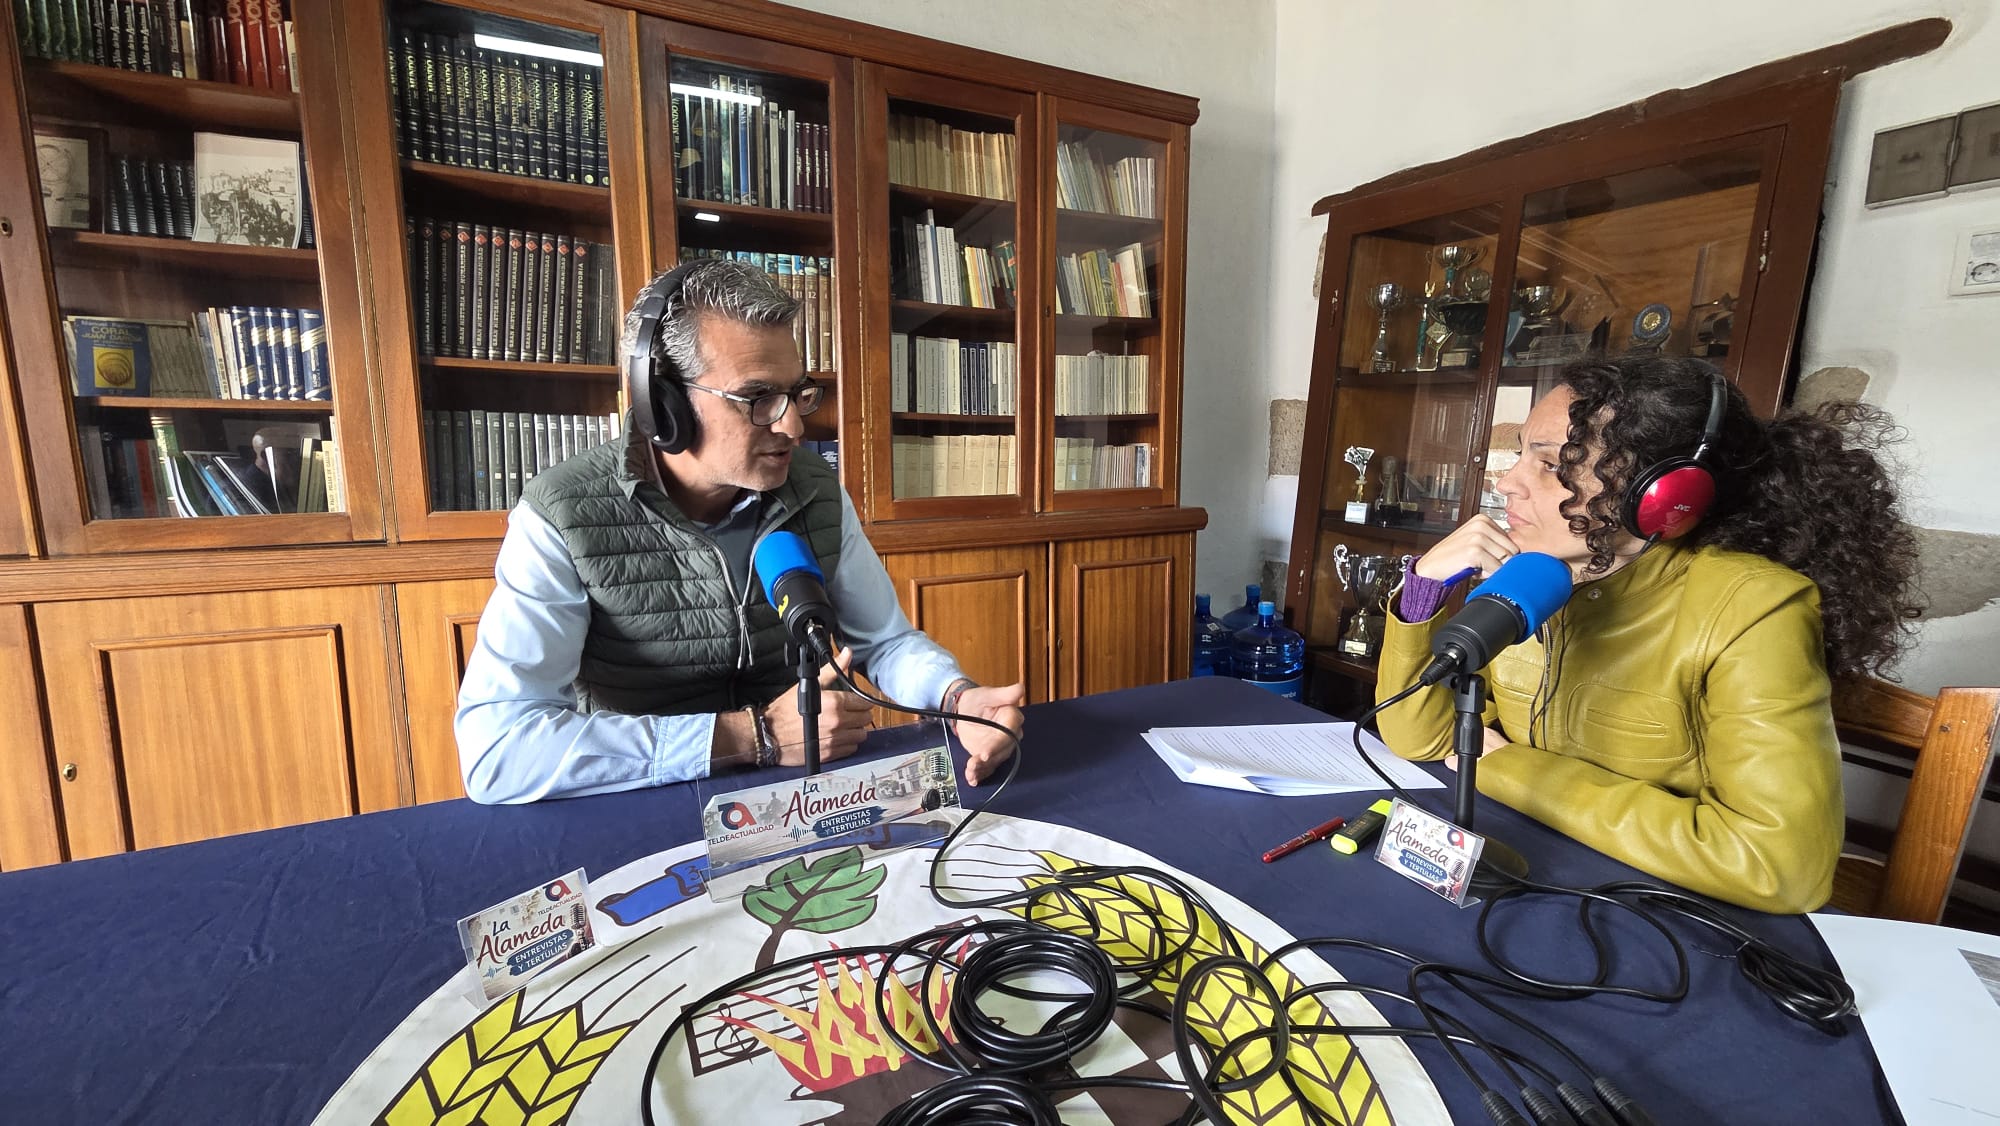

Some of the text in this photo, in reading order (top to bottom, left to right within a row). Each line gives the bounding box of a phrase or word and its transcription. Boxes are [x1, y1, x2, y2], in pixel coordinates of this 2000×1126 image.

[808, 291, 816, 299] 12
[577, 299, 582, 309] DE
[1673, 504, 1691, 512] JVC
[802, 780, 820, 796] La
[781, 781, 878, 828] Alameda
[821, 809, 871, 828] ENTREVISTAS
[831, 817, 871, 834] TERTULIAS
[1405, 818, 1418, 832] La
[708, 824, 774, 845] TELDEACTUALIDAD
[1387, 821, 1448, 867] Alameda
[1405, 852, 1444, 877] ENTREVISTAS
[492, 920, 511, 936] La
[476, 913, 565, 968] Alameda
[515, 932, 568, 963] ENTREVISTAS
[518, 964, 524, 972] Y
